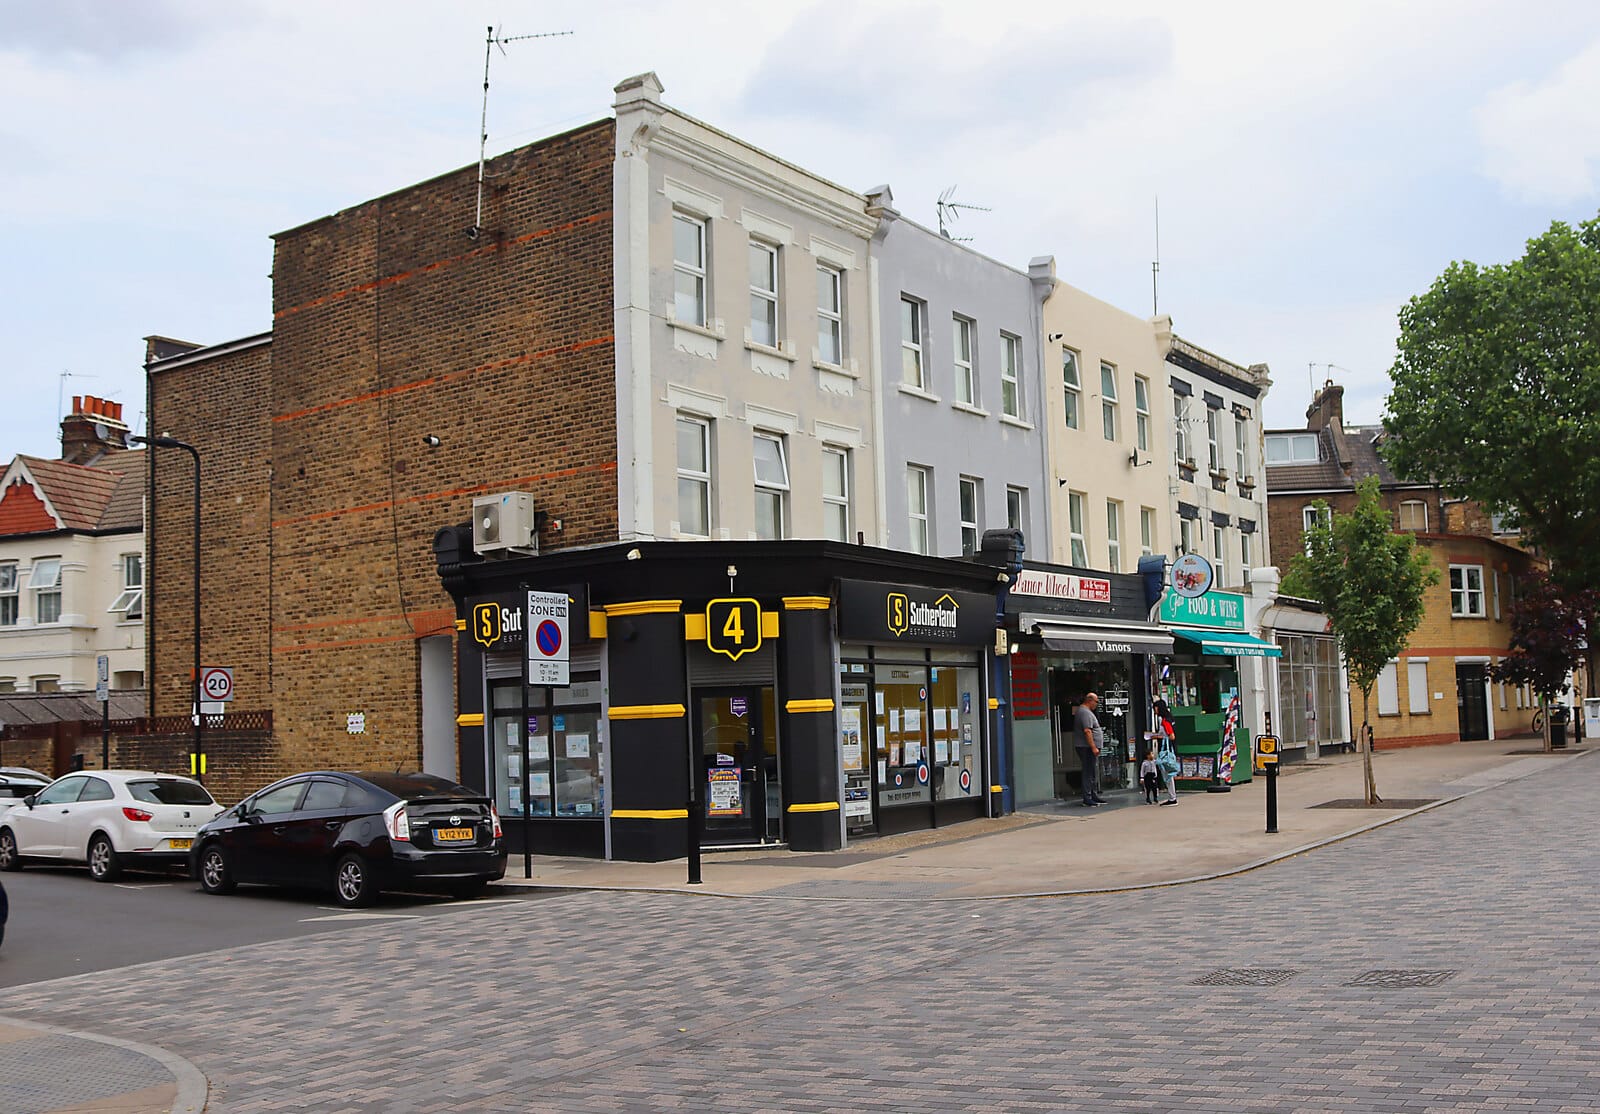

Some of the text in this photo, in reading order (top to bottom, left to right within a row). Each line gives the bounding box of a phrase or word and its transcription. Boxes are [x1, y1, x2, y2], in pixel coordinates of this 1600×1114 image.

[1044, 574, 1076, 597] Wheels
[530, 594, 566, 605] Controlled
[530, 605, 555, 616] ZONE
[1188, 596, 1208, 615] FOOD
[1210, 598, 1217, 617] &
[1219, 600, 1238, 619] WINE
[482, 608, 491, 637] S
[894, 598, 903, 627] S
[910, 601, 957, 628] Sutherland
[723, 607, 744, 644] 4
[910, 628, 957, 638] ESTATE AGENTS
[1096, 641, 1132, 653] Manors
[208, 678, 228, 690] 20
